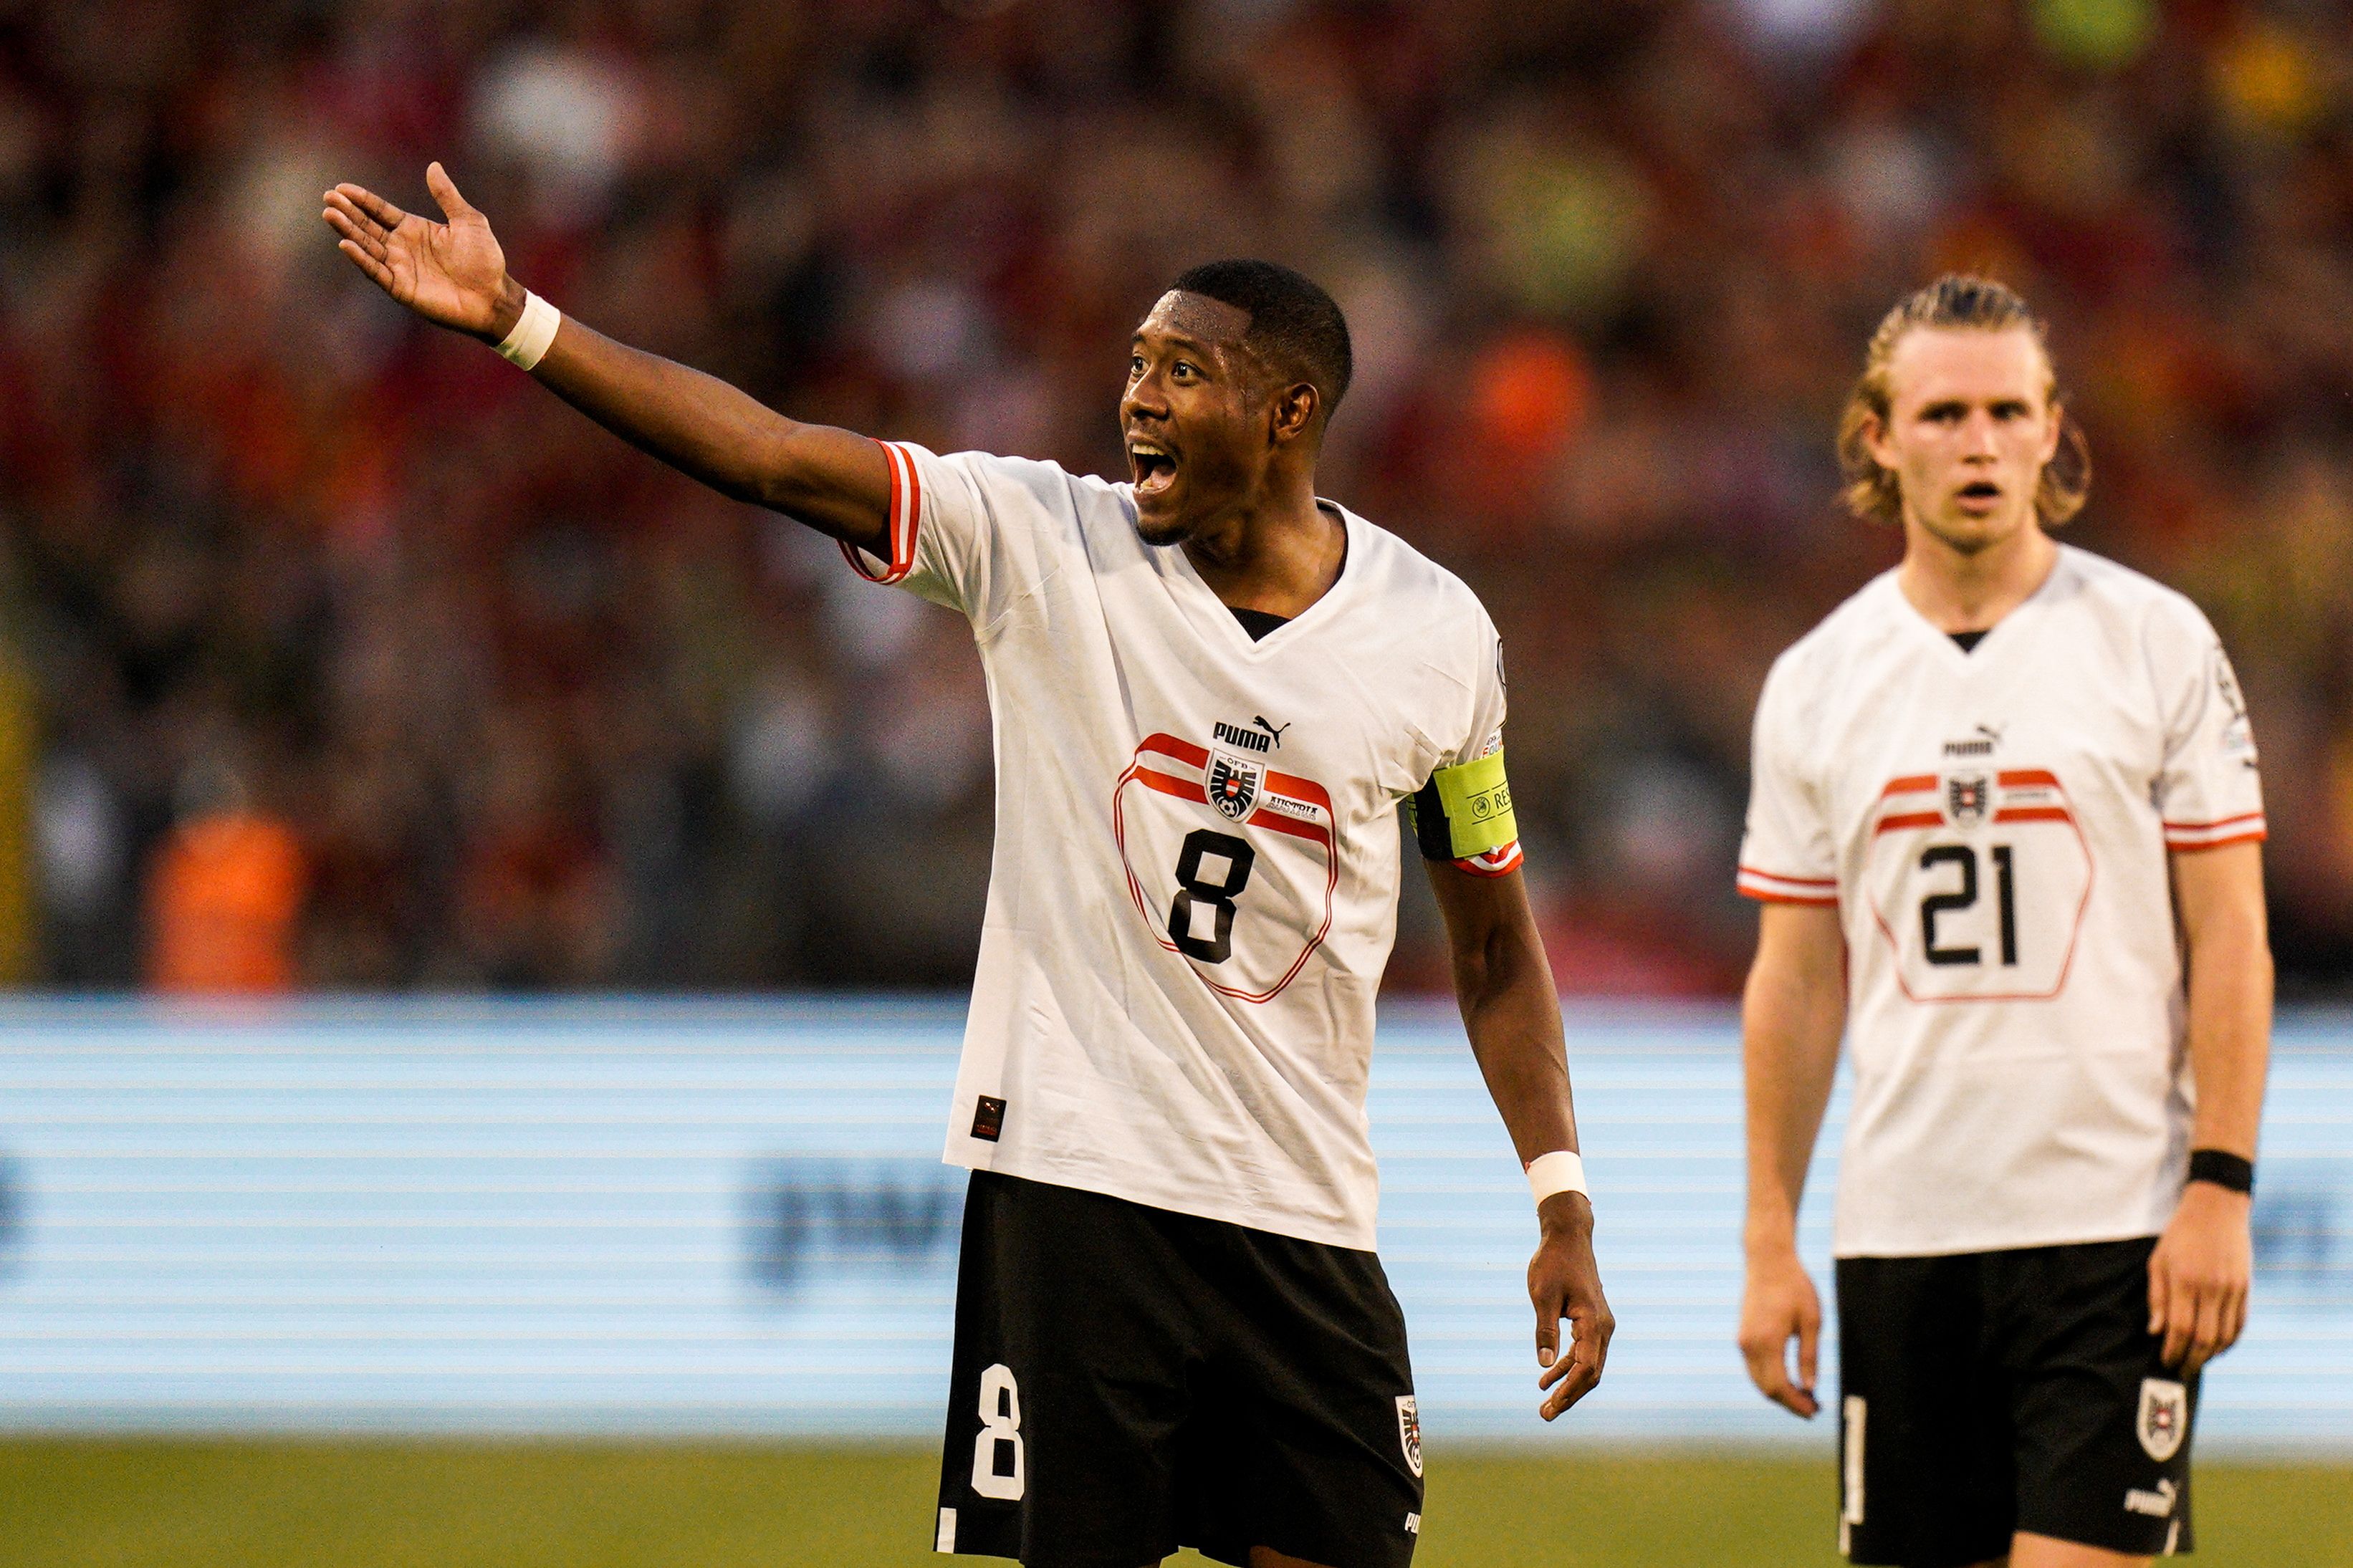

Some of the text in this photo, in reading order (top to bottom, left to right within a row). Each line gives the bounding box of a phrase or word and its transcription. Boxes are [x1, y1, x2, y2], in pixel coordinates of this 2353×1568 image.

[1212, 721, 1271, 753] PUMA
[1168, 829, 1255, 963] 8
[1920, 845, 2017, 966] 21
[971, 1363, 1025, 1501] 8
